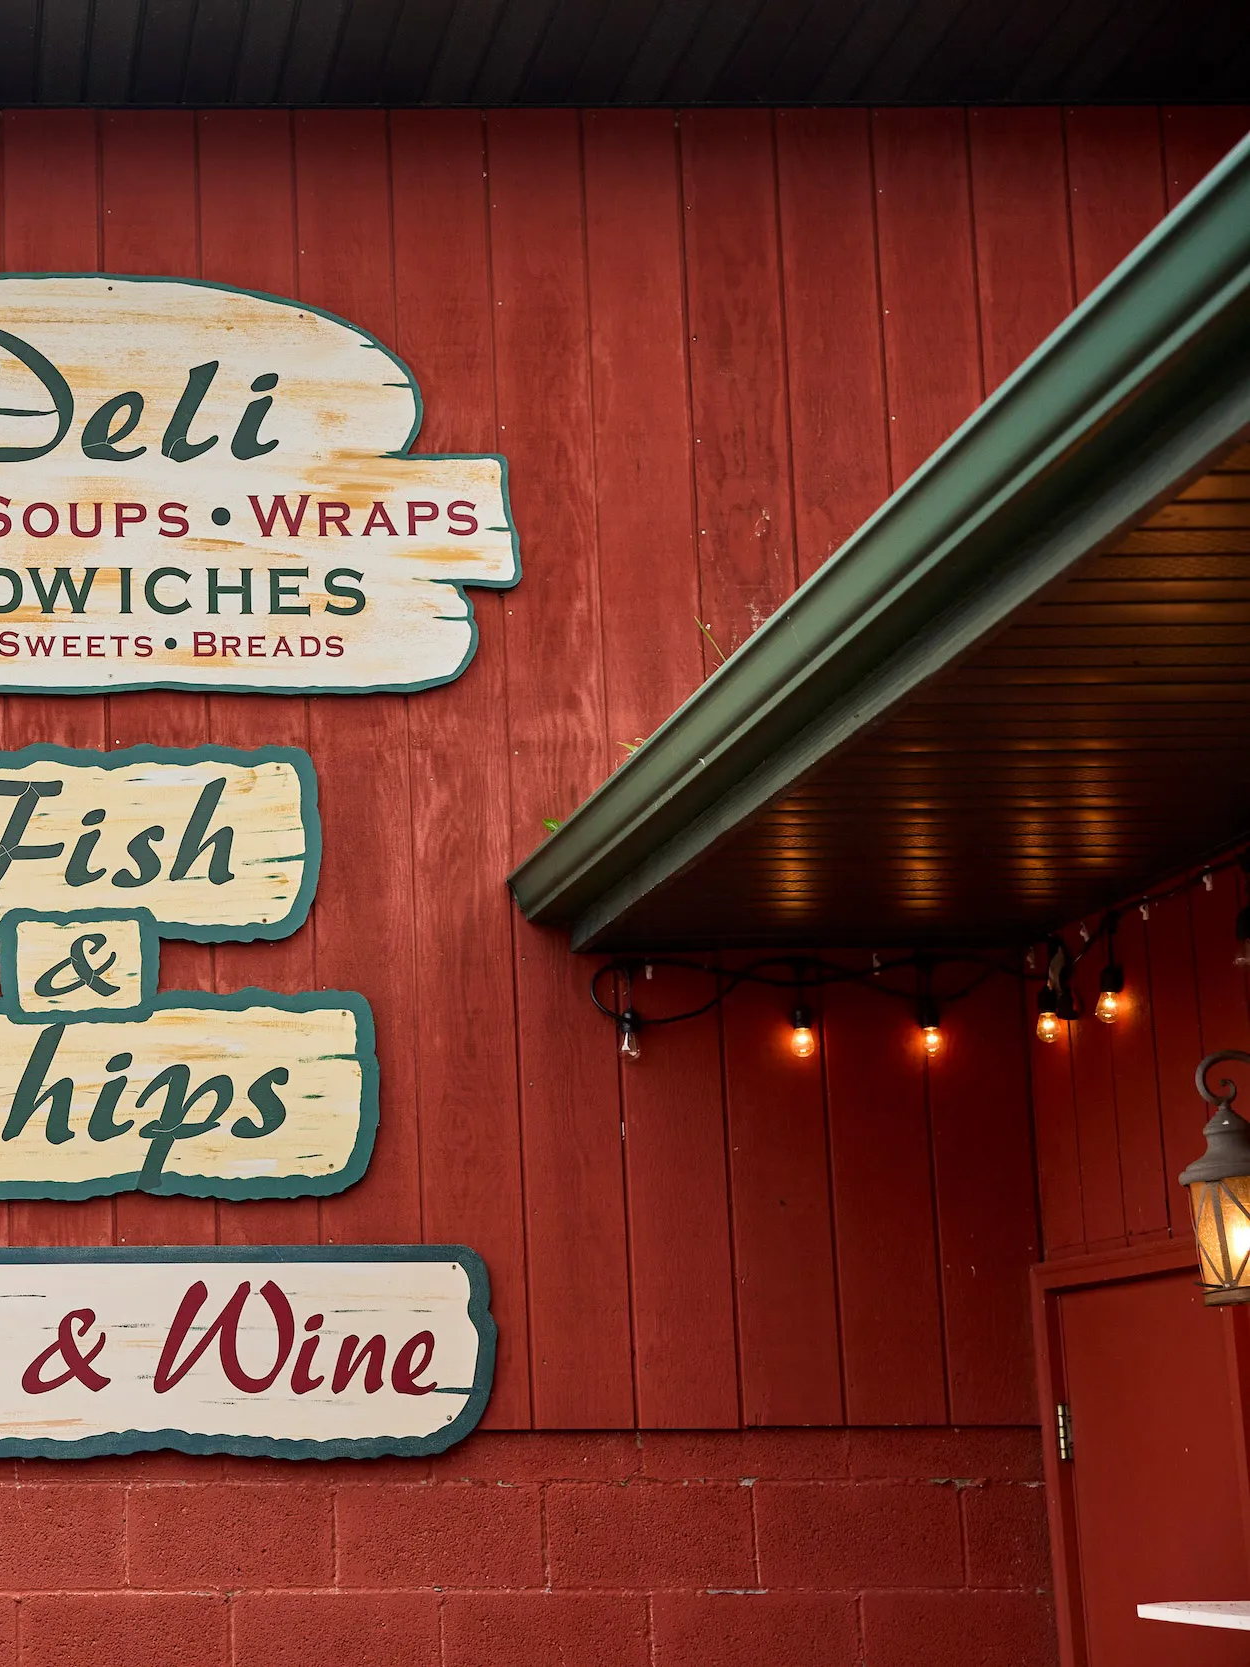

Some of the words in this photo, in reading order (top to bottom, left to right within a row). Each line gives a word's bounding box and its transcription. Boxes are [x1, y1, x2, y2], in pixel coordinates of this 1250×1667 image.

[248, 495, 478, 537] WRAPS
[192, 631, 344, 658] BREADS
[34, 933, 121, 997] &
[22, 1308, 111, 1395] &
[154, 1280, 437, 1395] Wine
